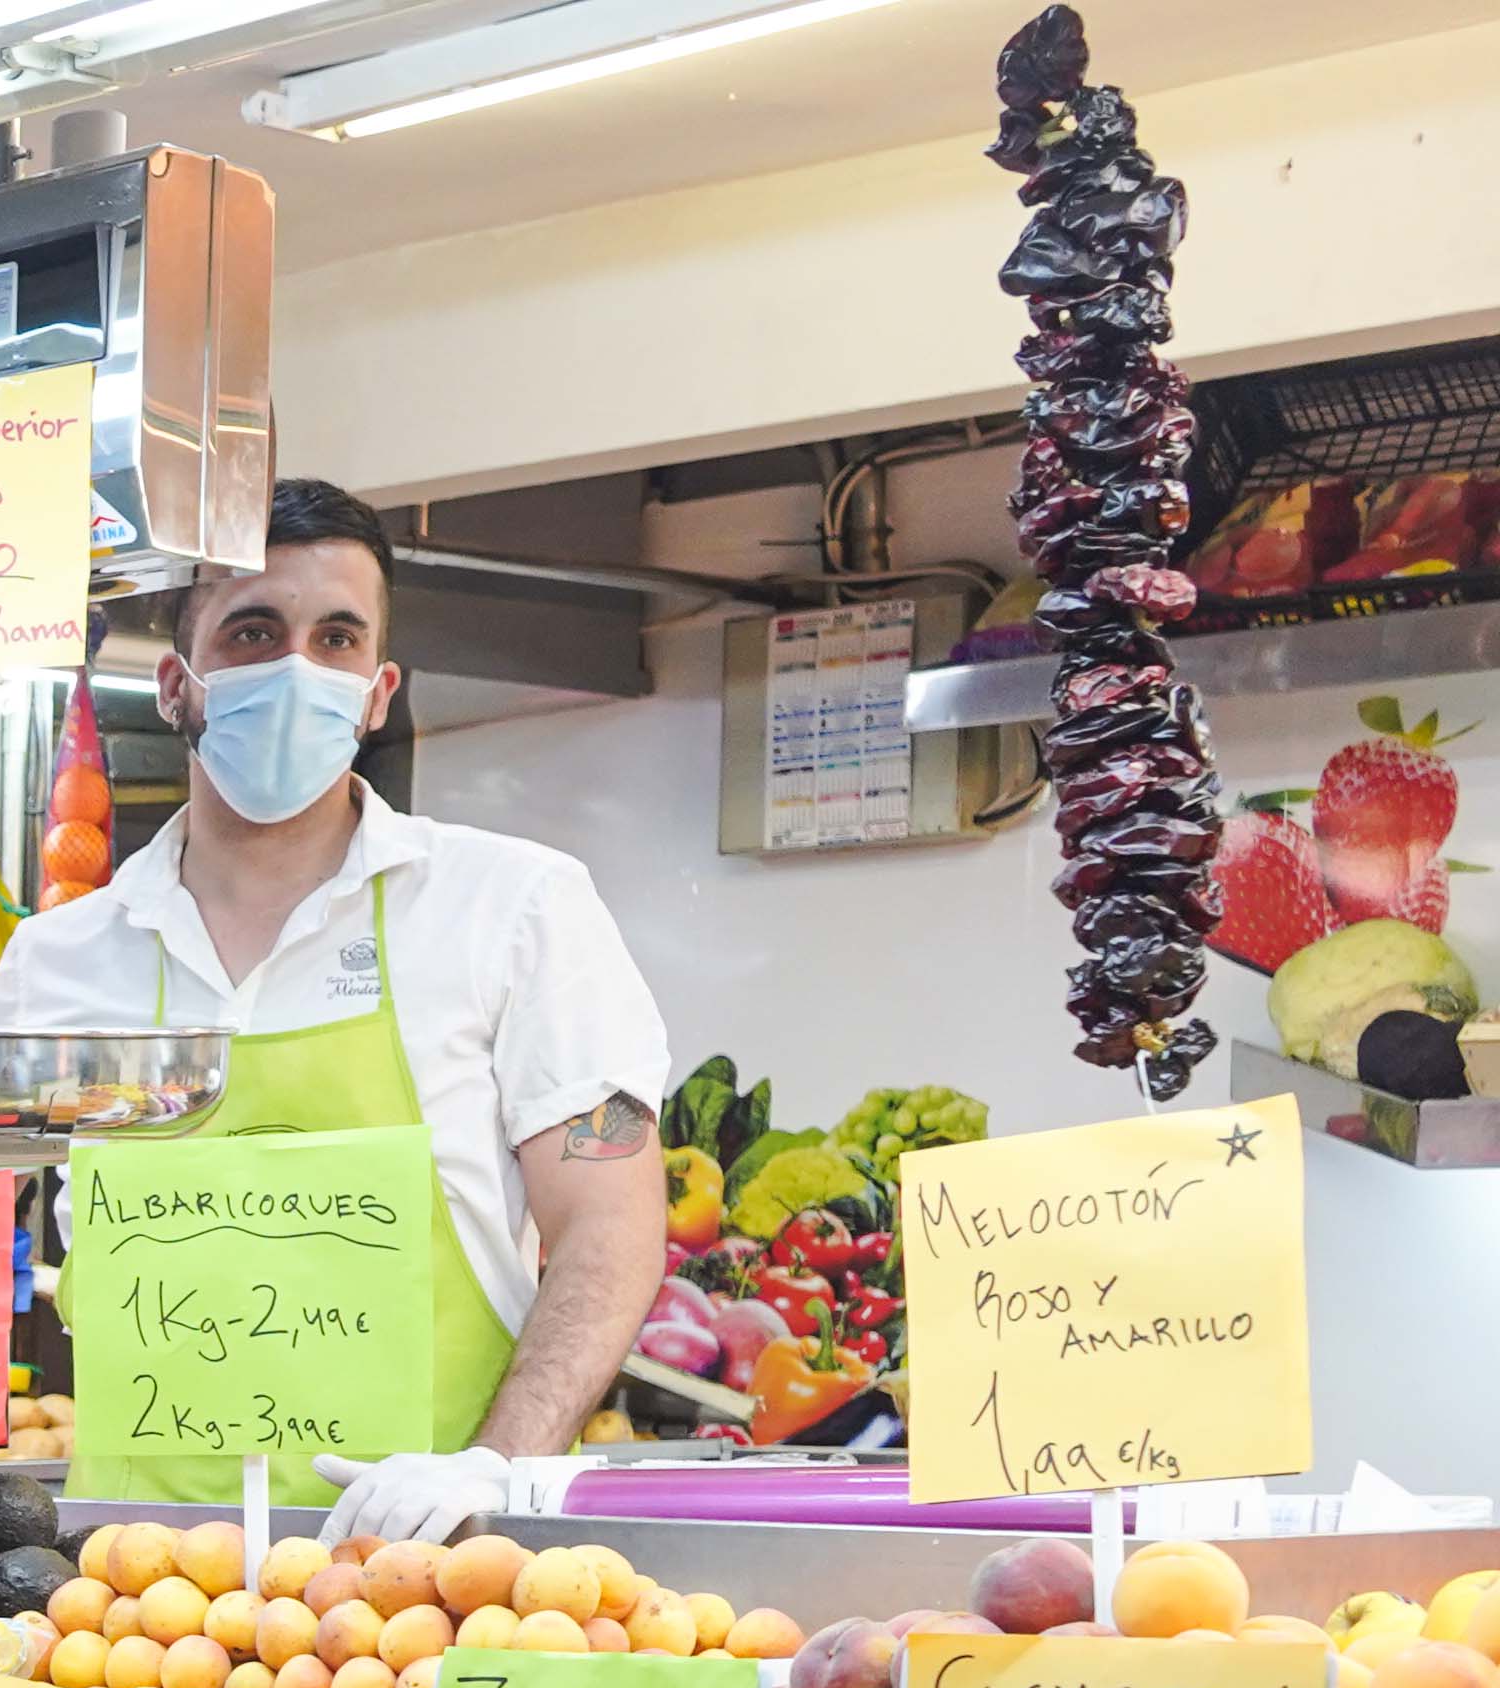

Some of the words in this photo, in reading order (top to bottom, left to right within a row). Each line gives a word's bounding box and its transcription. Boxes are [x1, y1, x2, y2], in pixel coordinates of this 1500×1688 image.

[87, 1170, 397, 1226] ALBARICOQUES
[918, 1161, 1204, 1259] MELOCOTÓN
[974, 1270, 1070, 1340] ROJO
[1093, 1274, 1119, 1306] Y
[1060, 1312, 1253, 1359] AMARILLO
[970, 1371, 1107, 1495] 1,99
